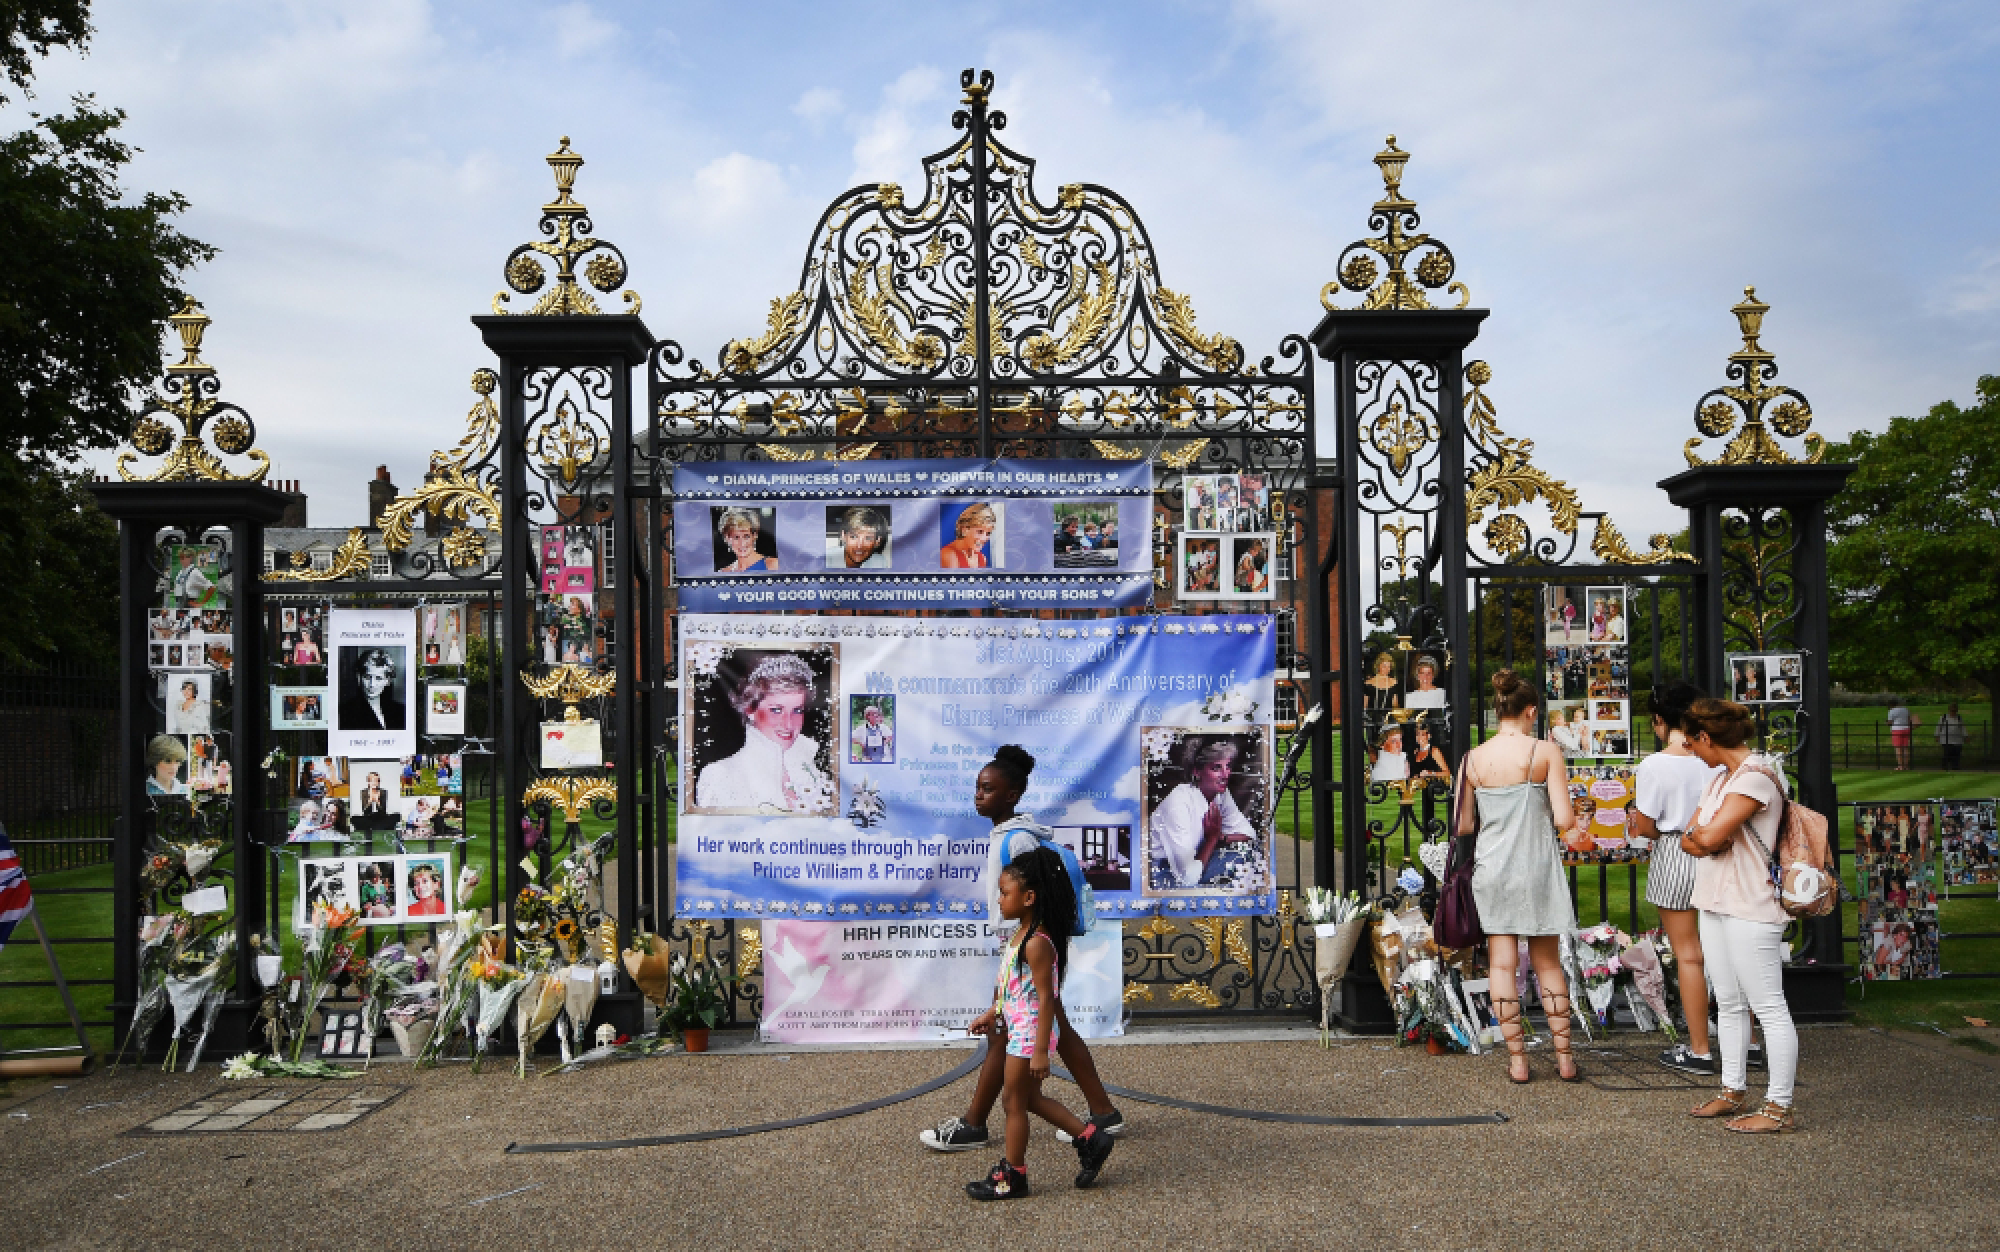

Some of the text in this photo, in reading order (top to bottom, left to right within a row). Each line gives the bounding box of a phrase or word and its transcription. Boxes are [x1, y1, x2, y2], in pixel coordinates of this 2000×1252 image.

[842, 473, 861, 484] OF
[864, 472, 911, 484] WALES
[931, 471, 995, 483] FOREVER
[997, 471, 1013, 483] IN
[1015, 471, 1045, 483] OUR
[1049, 472, 1103, 484] HEARTS
[735, 589, 1099, 602] YOUR GOOD WORK CONTINUES THROUGH YOUR SONS
[975, 639, 1127, 669] 31st August 2017
[864, 667, 1236, 696] We commemorate the 20th Anniversary of
[1002, 703, 1081, 727] Princess
[697, 835, 725, 854] Her
[727, 837, 765, 855] work
[769, 837, 847, 856] continues
[851, 838, 913, 860] through
[917, 839, 943, 857] her
[753, 861, 981, 882] Prince William & Prince Harry
[842, 925, 882, 942] HRH
[887, 923, 977, 941] PRINCESS
[857, 950, 893, 961] YEARS
[895, 949, 911, 959] ON
[914, 949, 937, 959] AND
[939, 948, 957, 958] WE
[959, 948, 989, 957] STILL
